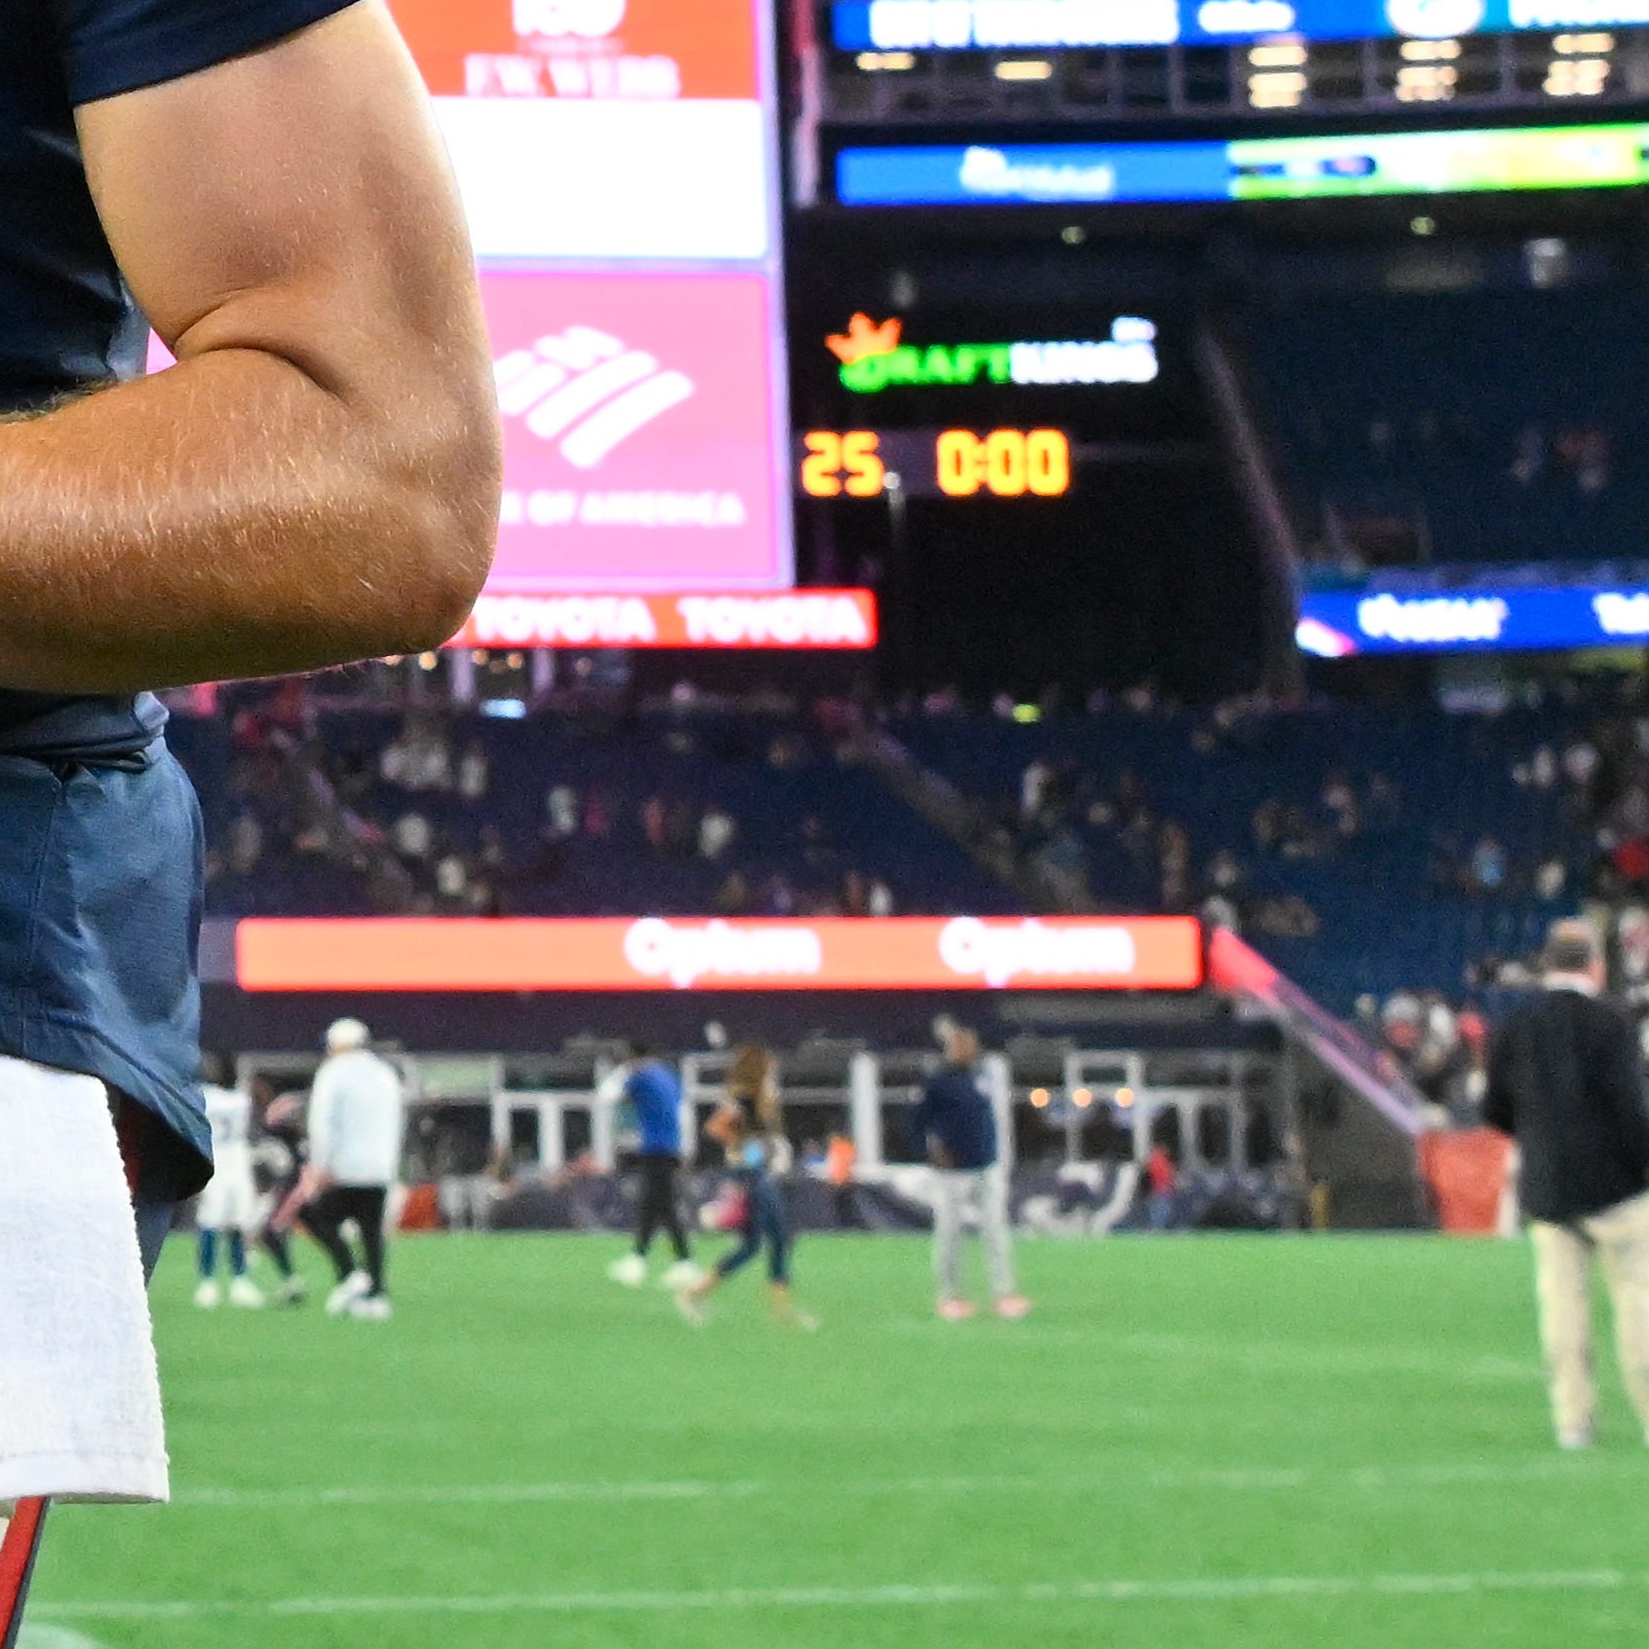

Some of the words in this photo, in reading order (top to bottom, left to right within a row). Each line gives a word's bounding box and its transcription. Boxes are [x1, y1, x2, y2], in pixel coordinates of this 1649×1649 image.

[801, 429, 885, 498] 25
[936, 427, 1069, 498] 0:00
[474, 596, 657, 642] TOYOTA
[677, 596, 867, 642] TOYOTA
